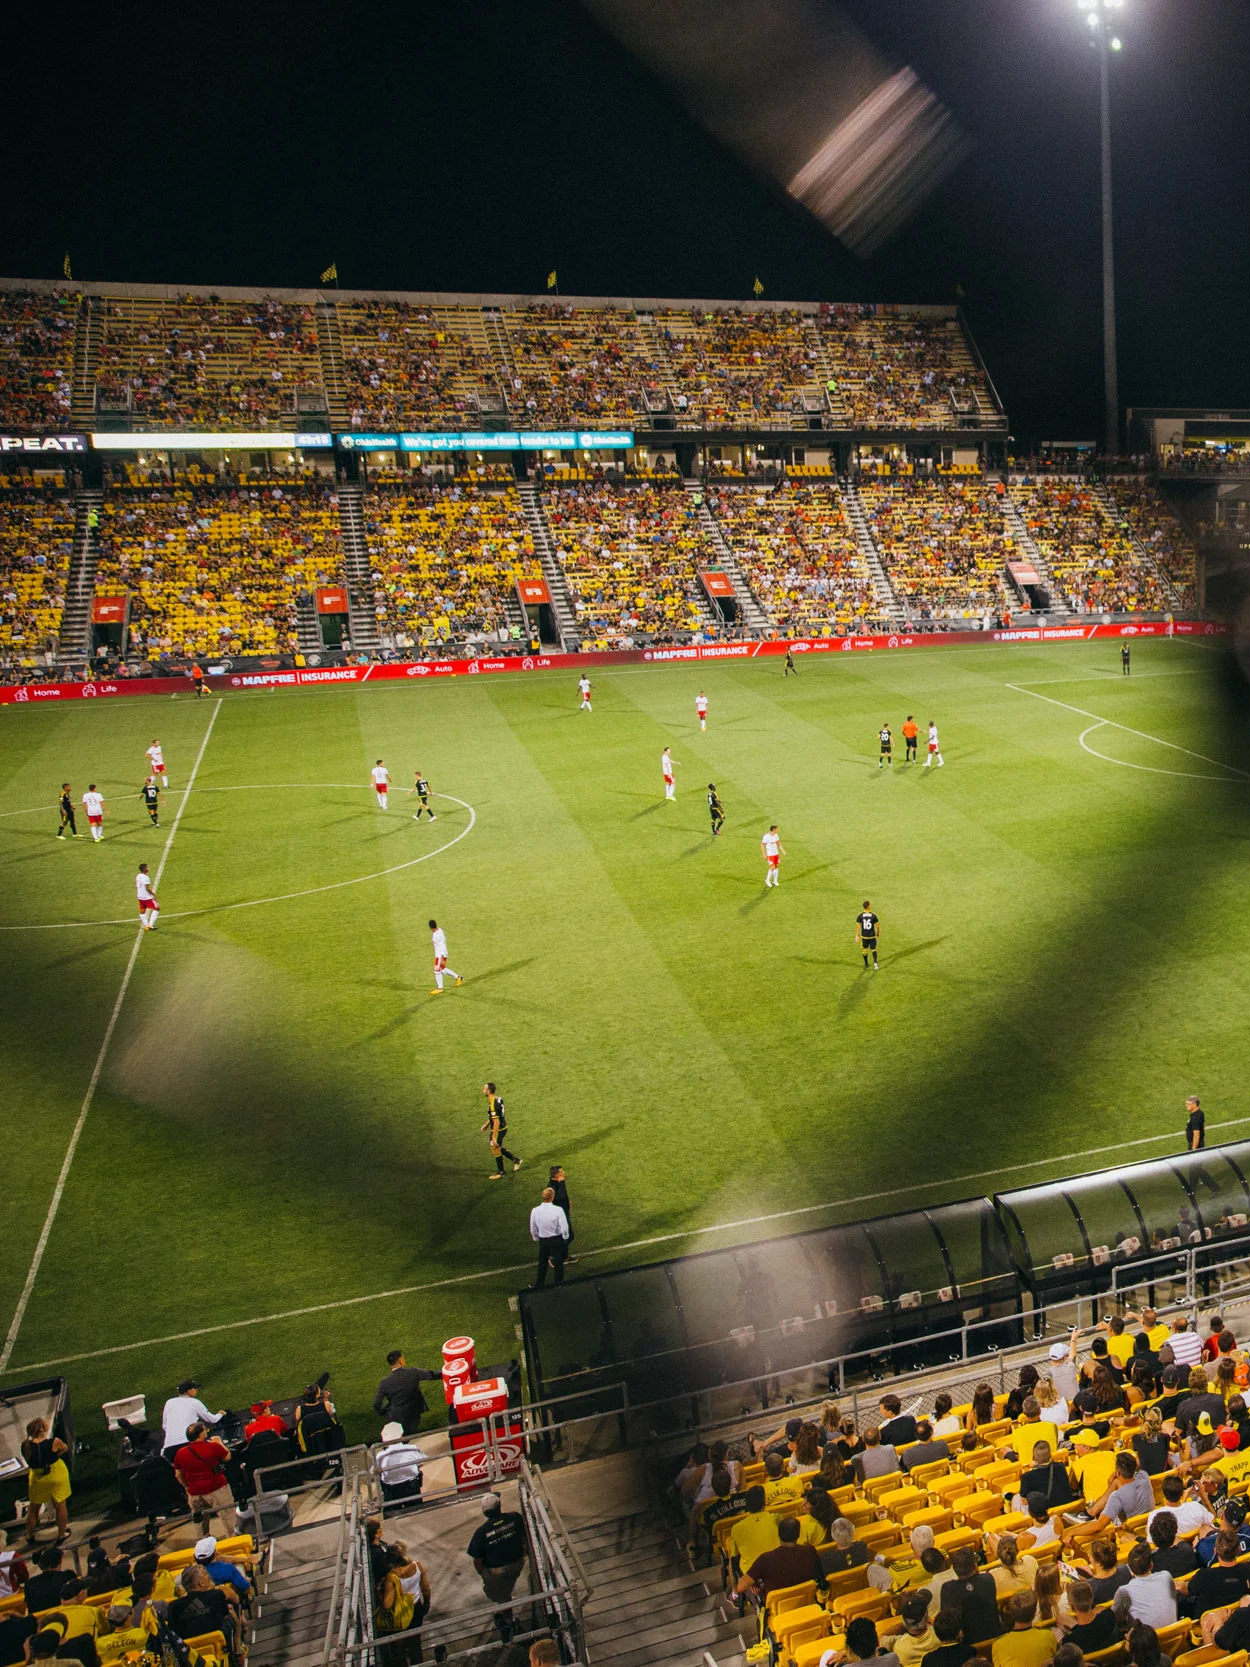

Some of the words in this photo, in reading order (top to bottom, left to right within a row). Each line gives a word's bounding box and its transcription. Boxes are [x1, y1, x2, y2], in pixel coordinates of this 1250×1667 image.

[404, 437, 431, 447] We've
[432, 438, 448, 448] got
[448, 439, 465, 449] you
[466, 437, 498, 447] covered
[499, 436, 520, 446] from
[551, 436, 560, 446] to
[1176, 624, 1193, 632] Home
[1001, 629, 1040, 641] MAPFRE
[1044, 628, 1084, 639] INSURANCE
[814, 641, 829, 649] Auto
[901, 637, 913, 645] Life
[653, 648, 697, 660] MAPFRE
[702, 646, 748, 656] INSURANCE
[483, 661, 505, 669] Home
[537, 658, 551, 666] Life
[434, 665, 453, 673] Auto
[242, 674, 295, 686] MAPFRE
[301, 670, 357, 682] INSURANCE
[33, 688, 61, 697] Home
[100, 685, 118, 693] Life
[862, 918, 872, 930] 16
[1230, 1461, 1249, 1473] TRAPP
[107, 1639, 136, 1651] DELEON
